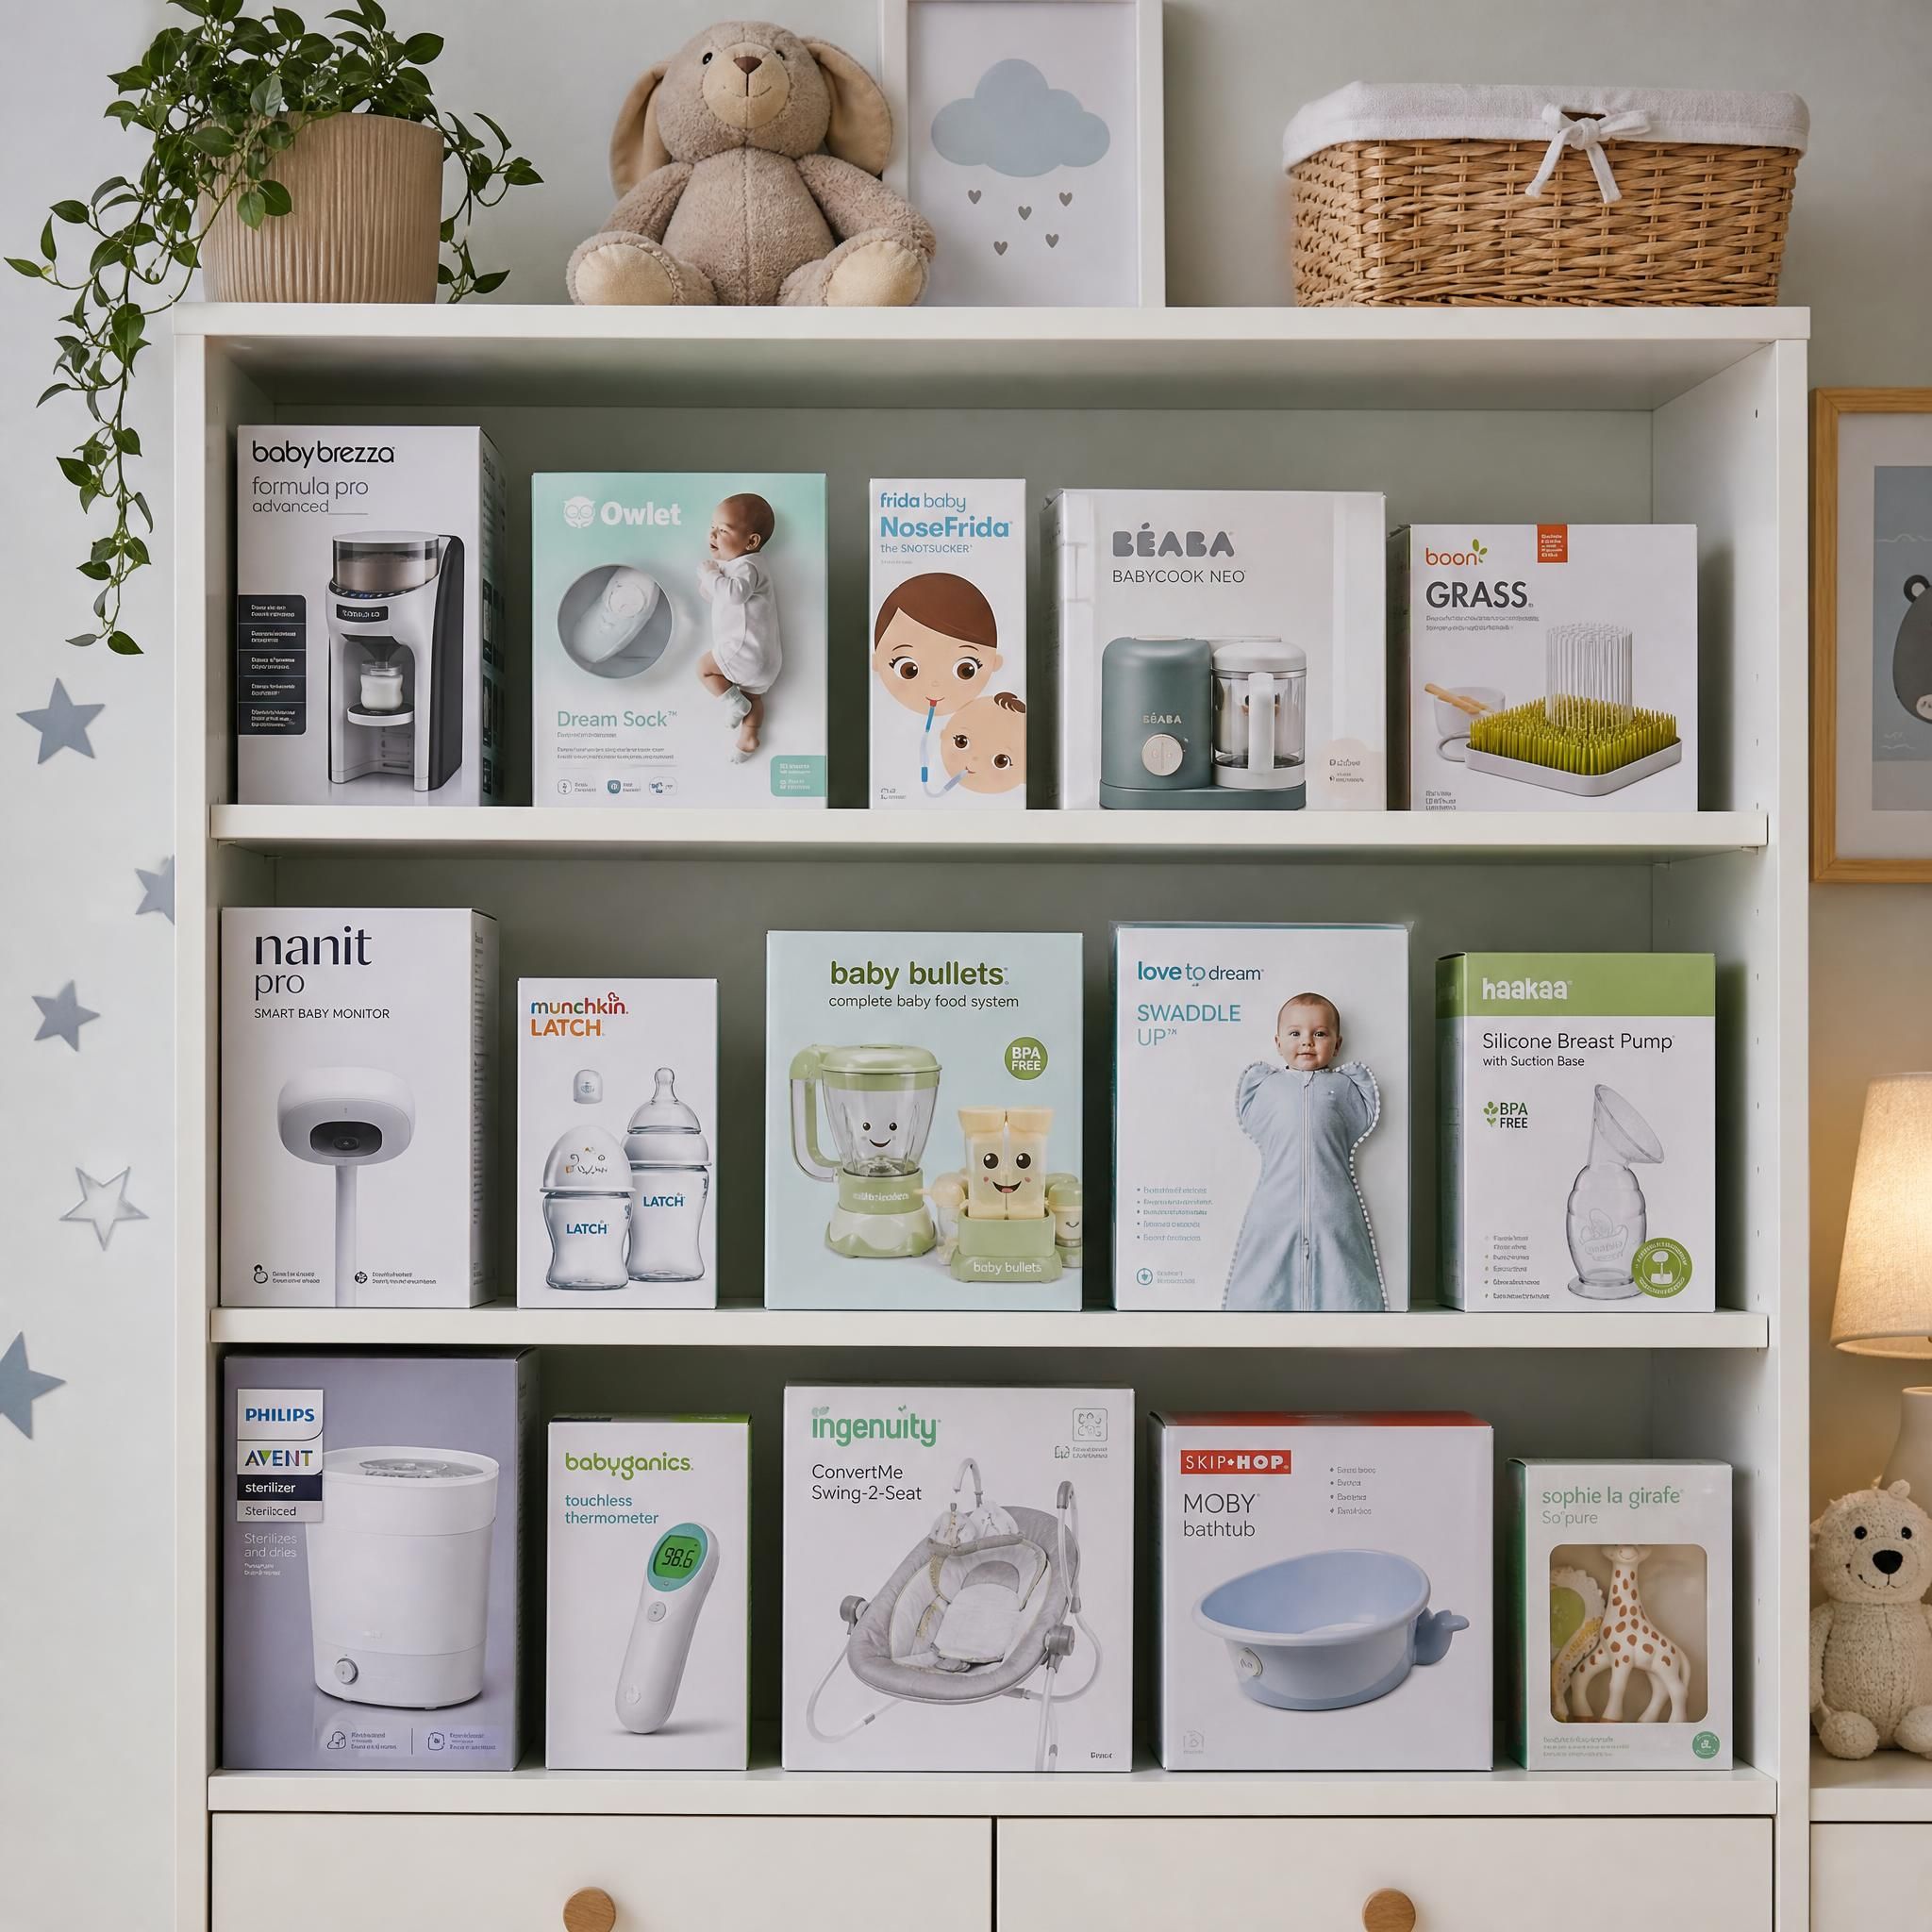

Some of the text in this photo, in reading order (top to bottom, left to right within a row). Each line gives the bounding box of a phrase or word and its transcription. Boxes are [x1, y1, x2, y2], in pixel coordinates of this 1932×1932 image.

[252, 475, 369, 499] formula pro
[252, 499, 329, 513] advanced
[880, 492, 967, 512] frida baby
[600, 501, 682, 526] Owlet
[880, 516, 1009, 538] NoseFrida
[880, 543, 970, 553] the SNOTSUCKER
[1112, 522, 1235, 558] BÉABA
[1425, 547, 1478, 566] boon
[1112, 570, 1245, 583] BABYCOOK NEO
[1425, 581, 1528, 608] GRASS
[558, 710, 618, 727] Dream
[255, 925, 373, 966] nanit
[831, 960, 1006, 991] baby bullets
[1138, 961, 1261, 980] love to dream
[255, 973, 305, 1001] pro
[1482, 977, 1568, 1000] haakaa
[829, 994, 1020, 1008] complete baby food system
[254, 1008, 391, 1019] SMART BABY MONITOR
[1137, 1004, 1241, 1022] SWADDLE
[531, 1019, 602, 1037] LATCH
[1482, 1032, 1674, 1053] Silicone Breast Pump
[1011, 1046, 1041, 1059] BPA
[1011, 1060, 1041, 1071] FREE
[1482, 1056, 1585, 1067] with Suction Base
[1499, 1102, 1528, 1116] BPA
[1499, 1117, 1528, 1129] FREE
[643, 1196, 684, 1208] LATCH
[566, 1223, 608, 1235] LATCH
[974, 1261, 1042, 1274] baby bullets
[245, 1408, 315, 1423] PHILIPS
[811, 1405, 938, 1447] ingenuity
[244, 1450, 313, 1467] AVENT
[811, 1463, 904, 1480] ConvertMe
[244, 1482, 296, 1493] sterilizer
[811, 1485, 923, 1503] Swing-2-Seat
[565, 1493, 633, 1507] touchless
[1184, 1493, 1257, 1513] MOBY
[1541, 1486, 1680, 1509] sophie la girafe
[565, 1511, 659, 1524] thermometer
[1184, 1520, 1256, 1538] bathtub
[244, 1532, 298, 1544] Sterilizes
[244, 1546, 297, 1557] and dries
[661, 1547, 695, 1569] 98.6
